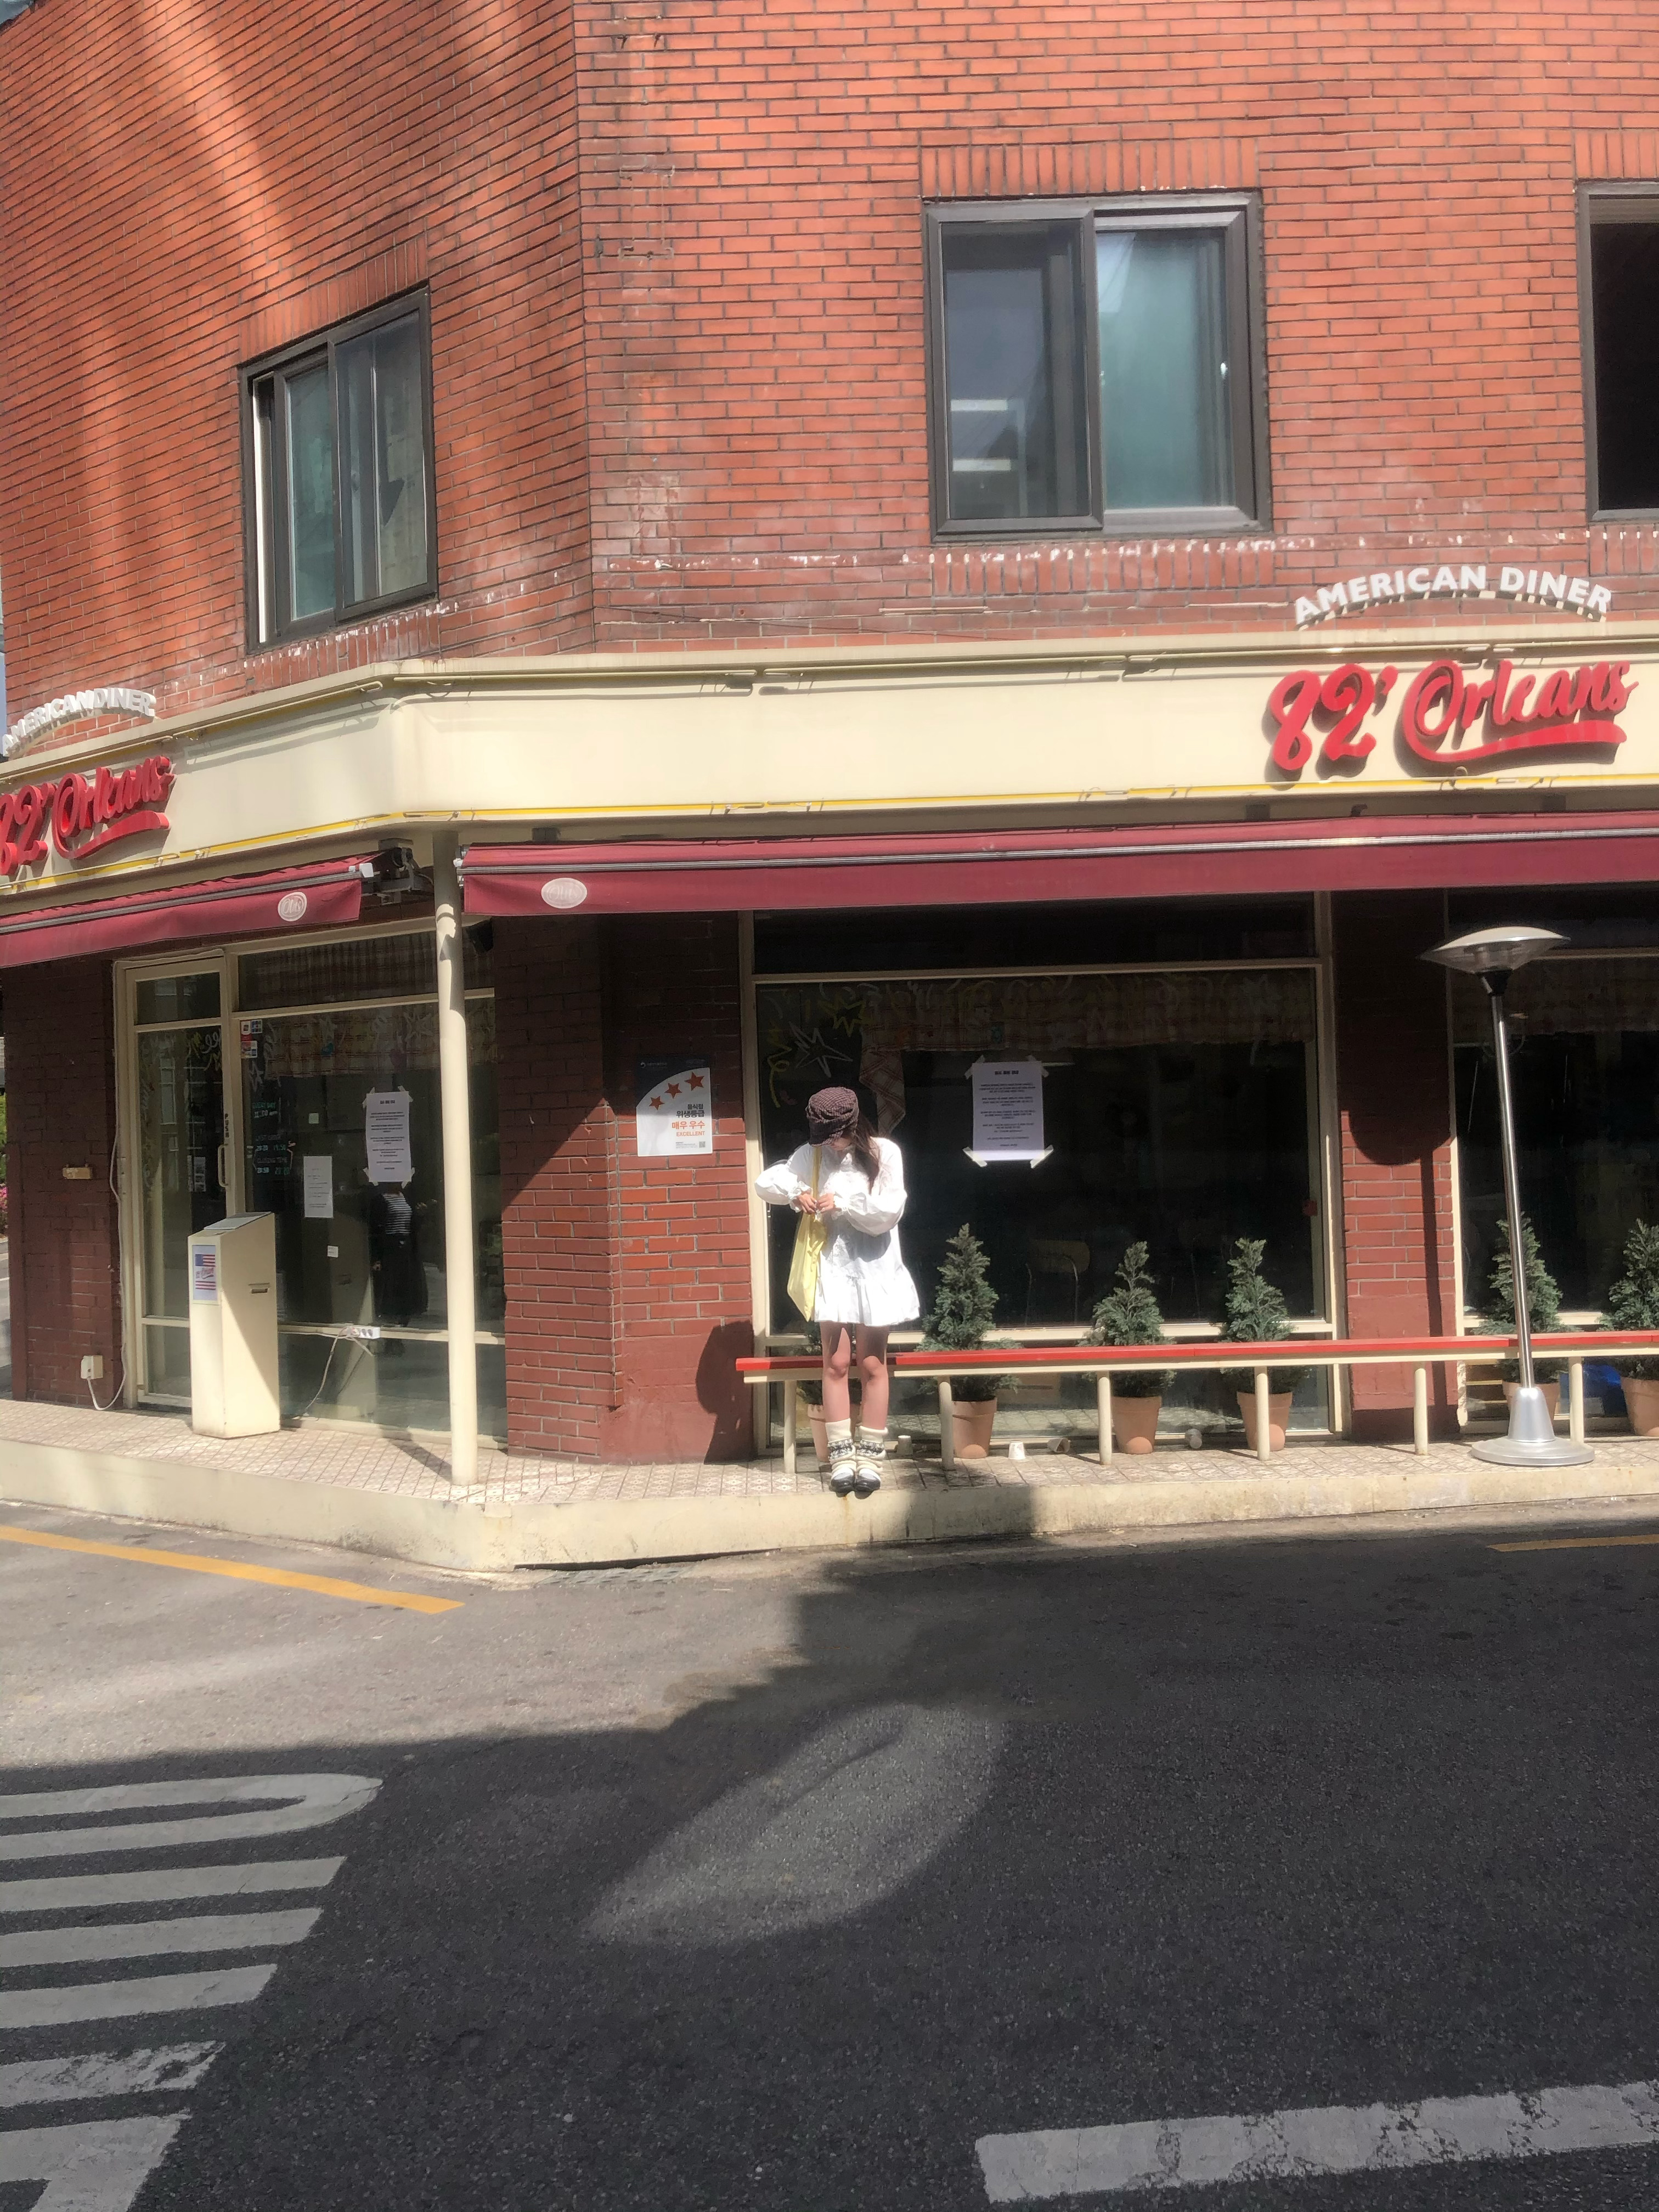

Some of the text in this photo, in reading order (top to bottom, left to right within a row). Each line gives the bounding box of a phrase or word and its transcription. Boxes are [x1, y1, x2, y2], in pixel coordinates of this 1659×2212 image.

[1295, 566, 1612, 625] AMERICAN DINER
[3, 687, 156, 757] AMERICAN DINER
[1403, 659, 1639, 763] Orleans
[52, 755, 174, 860] Orleans
[672, 1120, 705, 1130] 매우 우수
[676, 1110, 705, 1118] 위생등급
